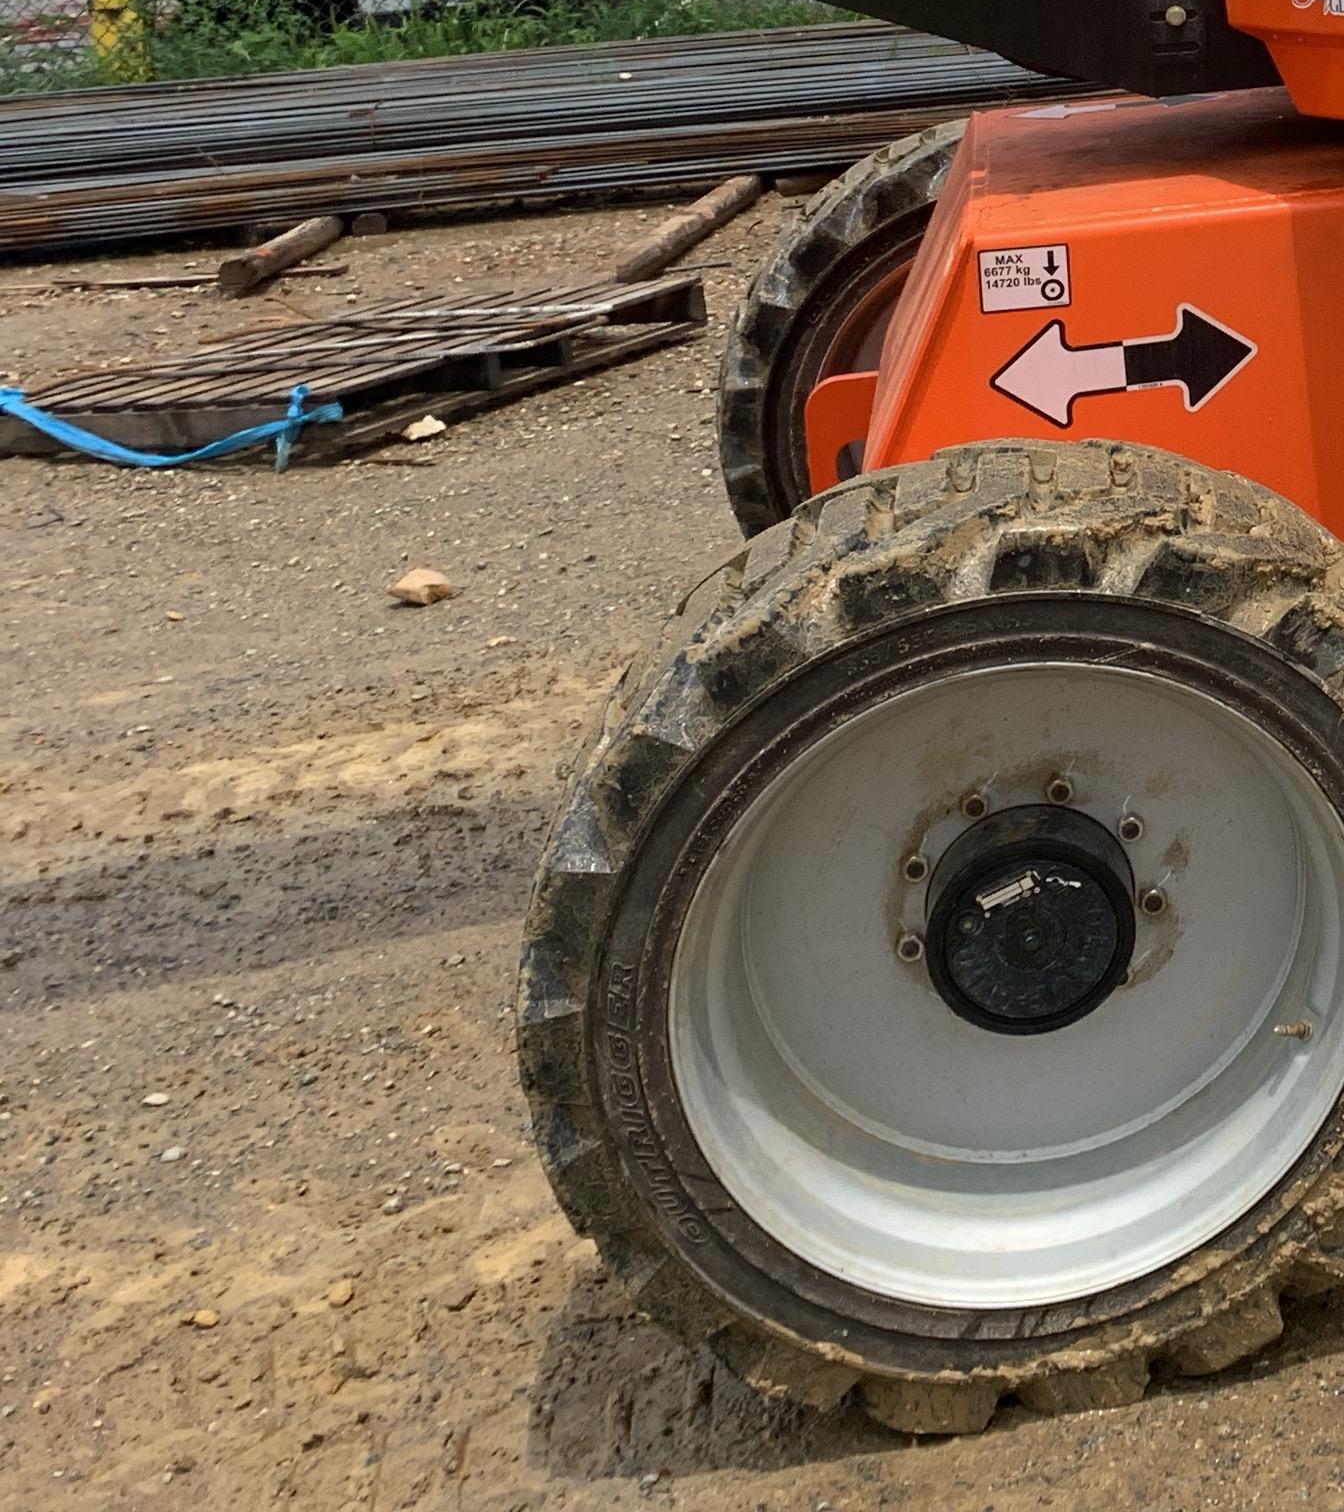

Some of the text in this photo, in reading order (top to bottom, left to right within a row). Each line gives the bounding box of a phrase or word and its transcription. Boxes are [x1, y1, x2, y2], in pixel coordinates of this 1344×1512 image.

[995, 254, 1023, 266] MAX
[984, 265, 1030, 278] 6677 kg
[986, 276, 1042, 289] 14720 lbs
[600, 962, 711, 1246] OUTRIGGER
